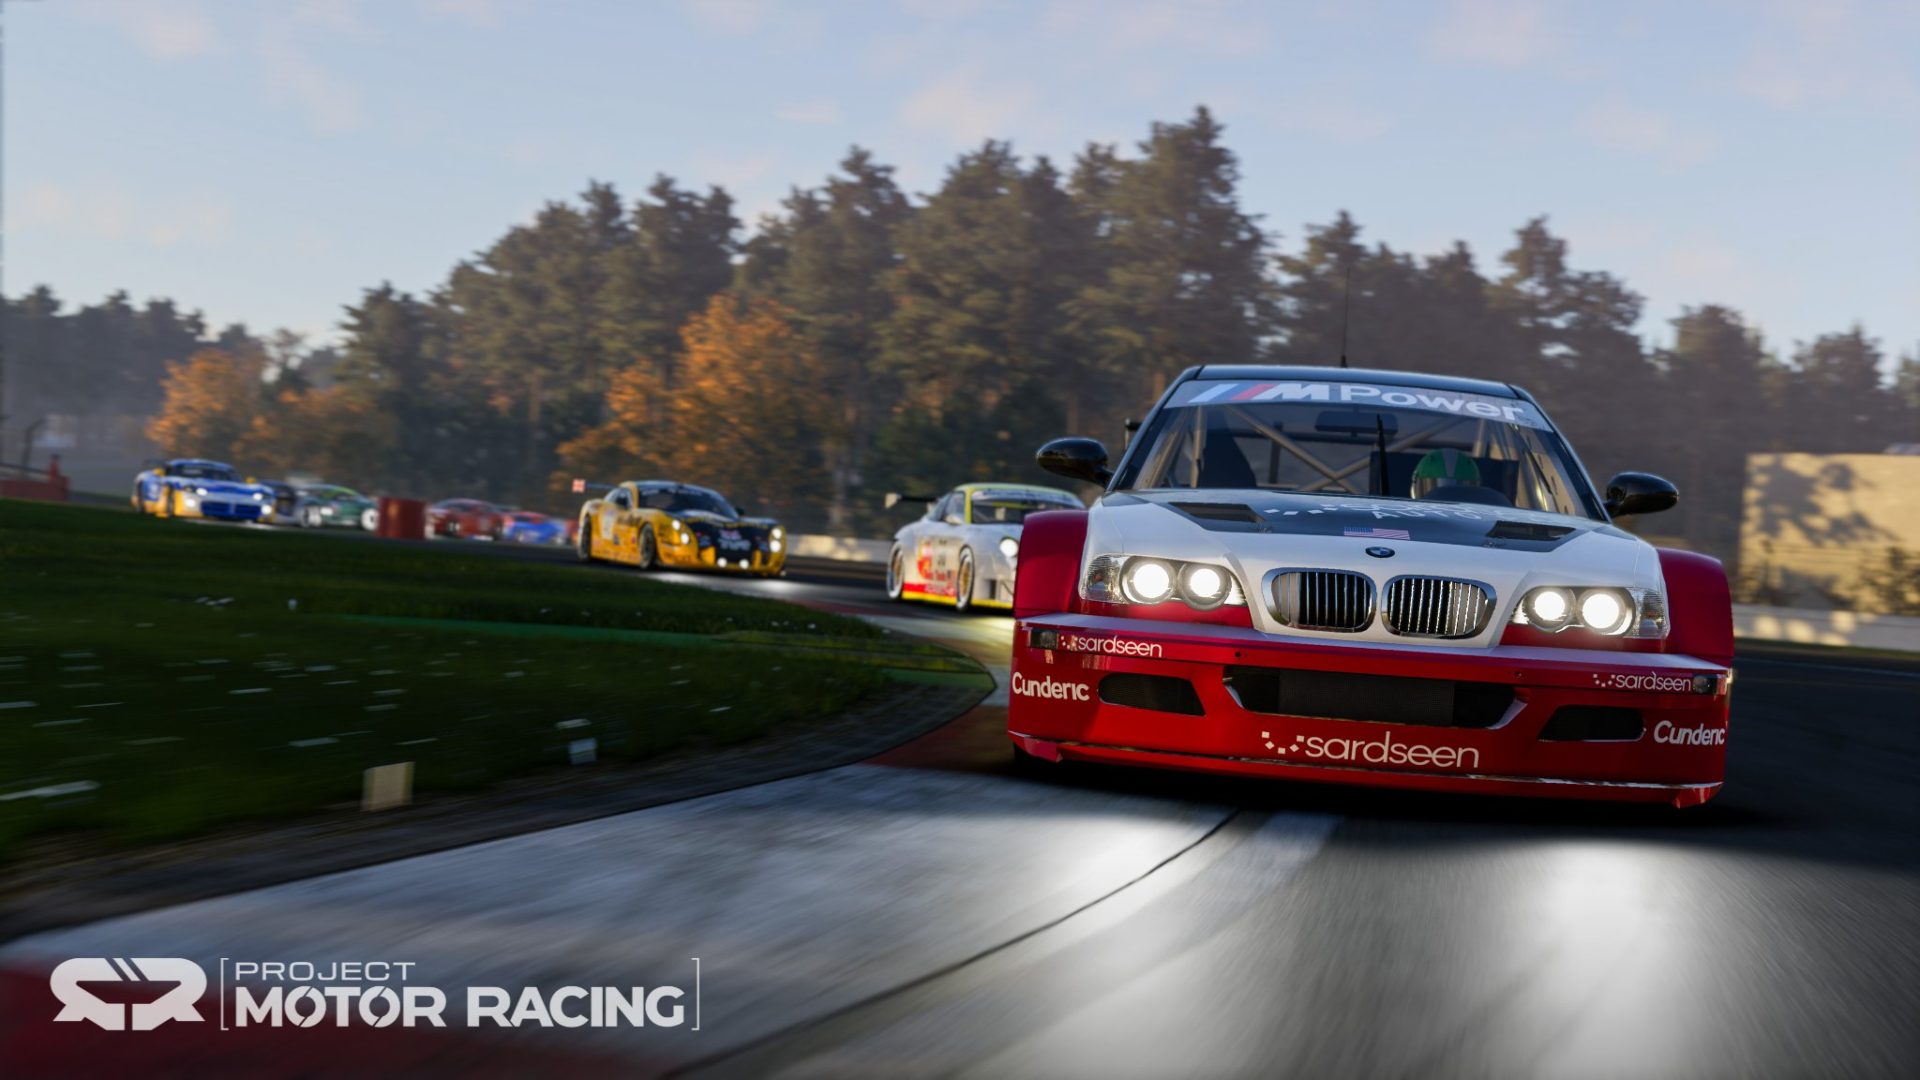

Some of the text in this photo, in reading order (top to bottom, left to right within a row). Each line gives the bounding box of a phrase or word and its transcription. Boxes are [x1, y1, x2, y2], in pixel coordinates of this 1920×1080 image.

[1078, 635, 1162, 657] sardseen
[1011, 671, 1090, 701] Cunderic
[1615, 671, 1692, 692] sardseen
[1653, 720, 1726, 745] Cunderic
[1304, 731, 1480, 769] sardseen
